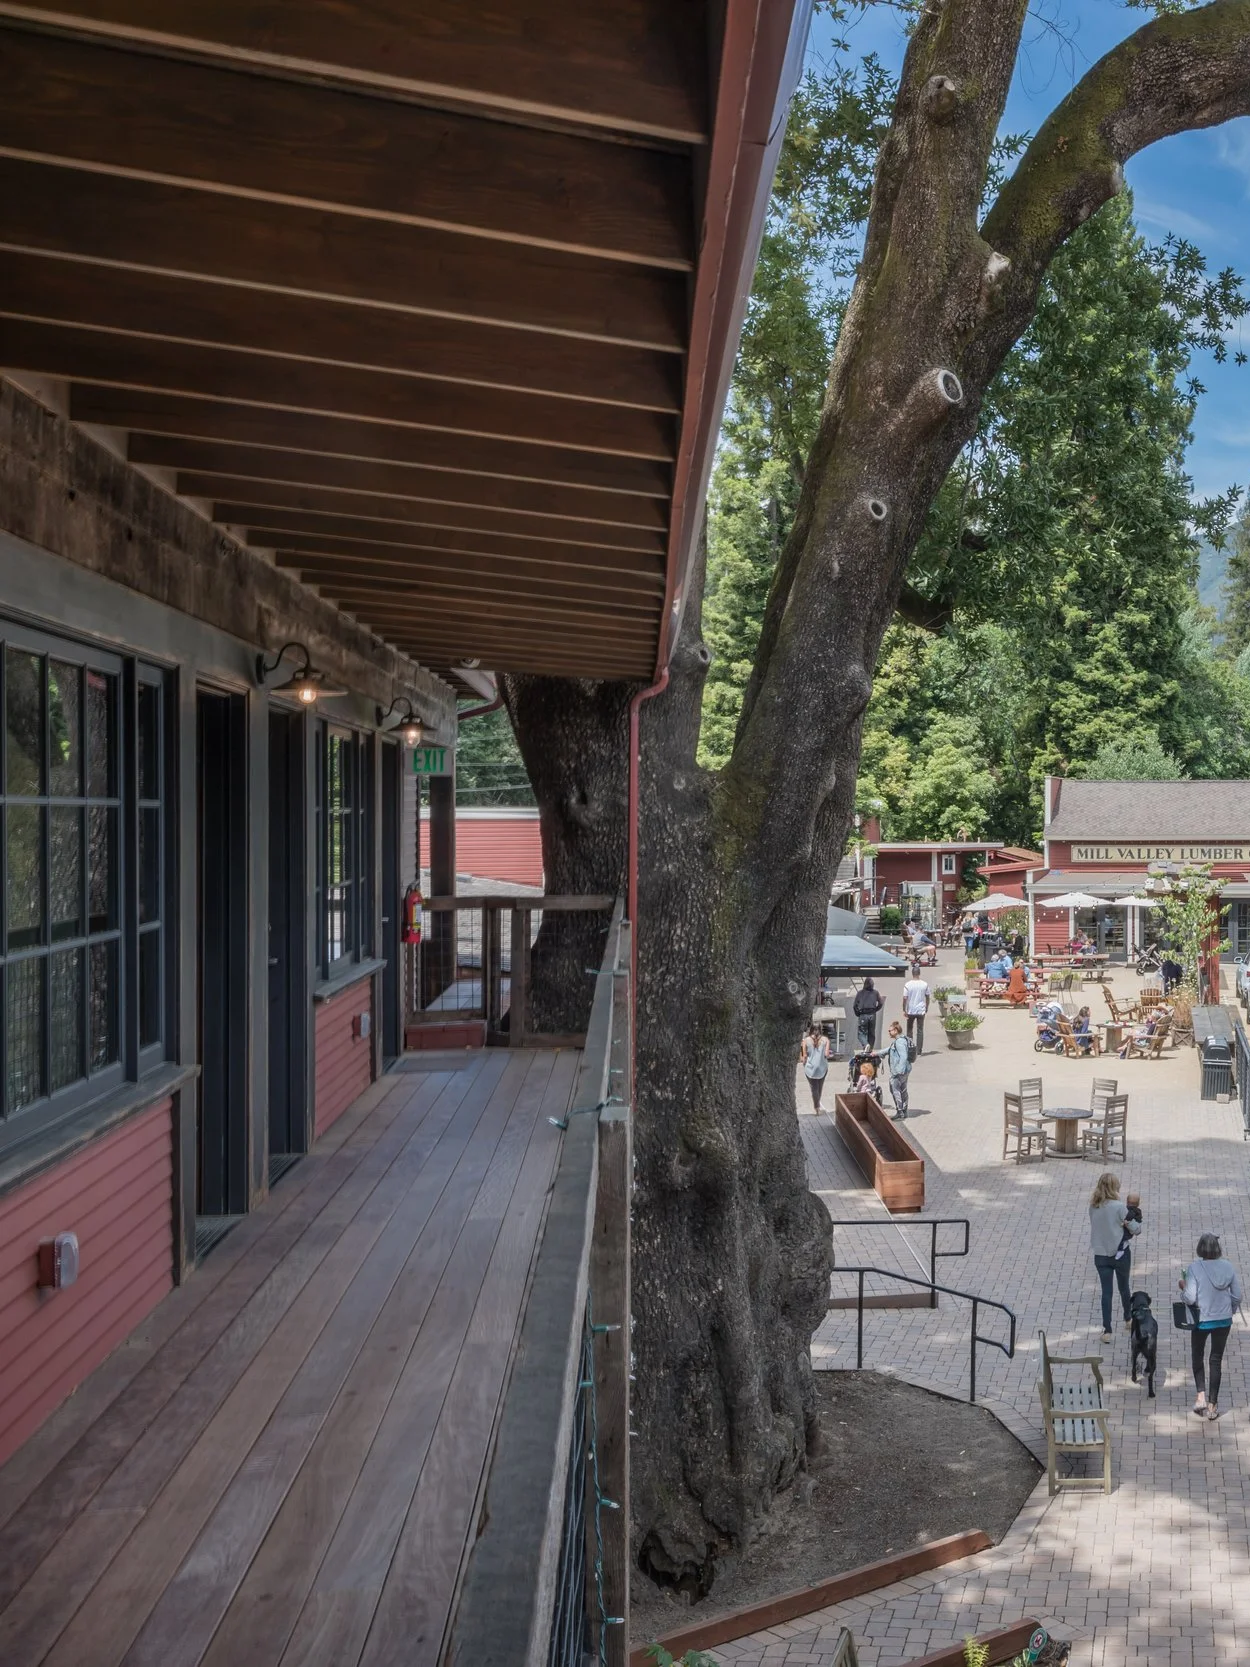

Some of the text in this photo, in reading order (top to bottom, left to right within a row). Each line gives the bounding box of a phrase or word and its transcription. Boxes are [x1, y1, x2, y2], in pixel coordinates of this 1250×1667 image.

[413, 748, 446, 772] EXIT
[1077, 848, 1113, 860] MILL
[1117, 848, 1175, 860] VALLEY
[1180, 848, 1244, 860] LUMBER
